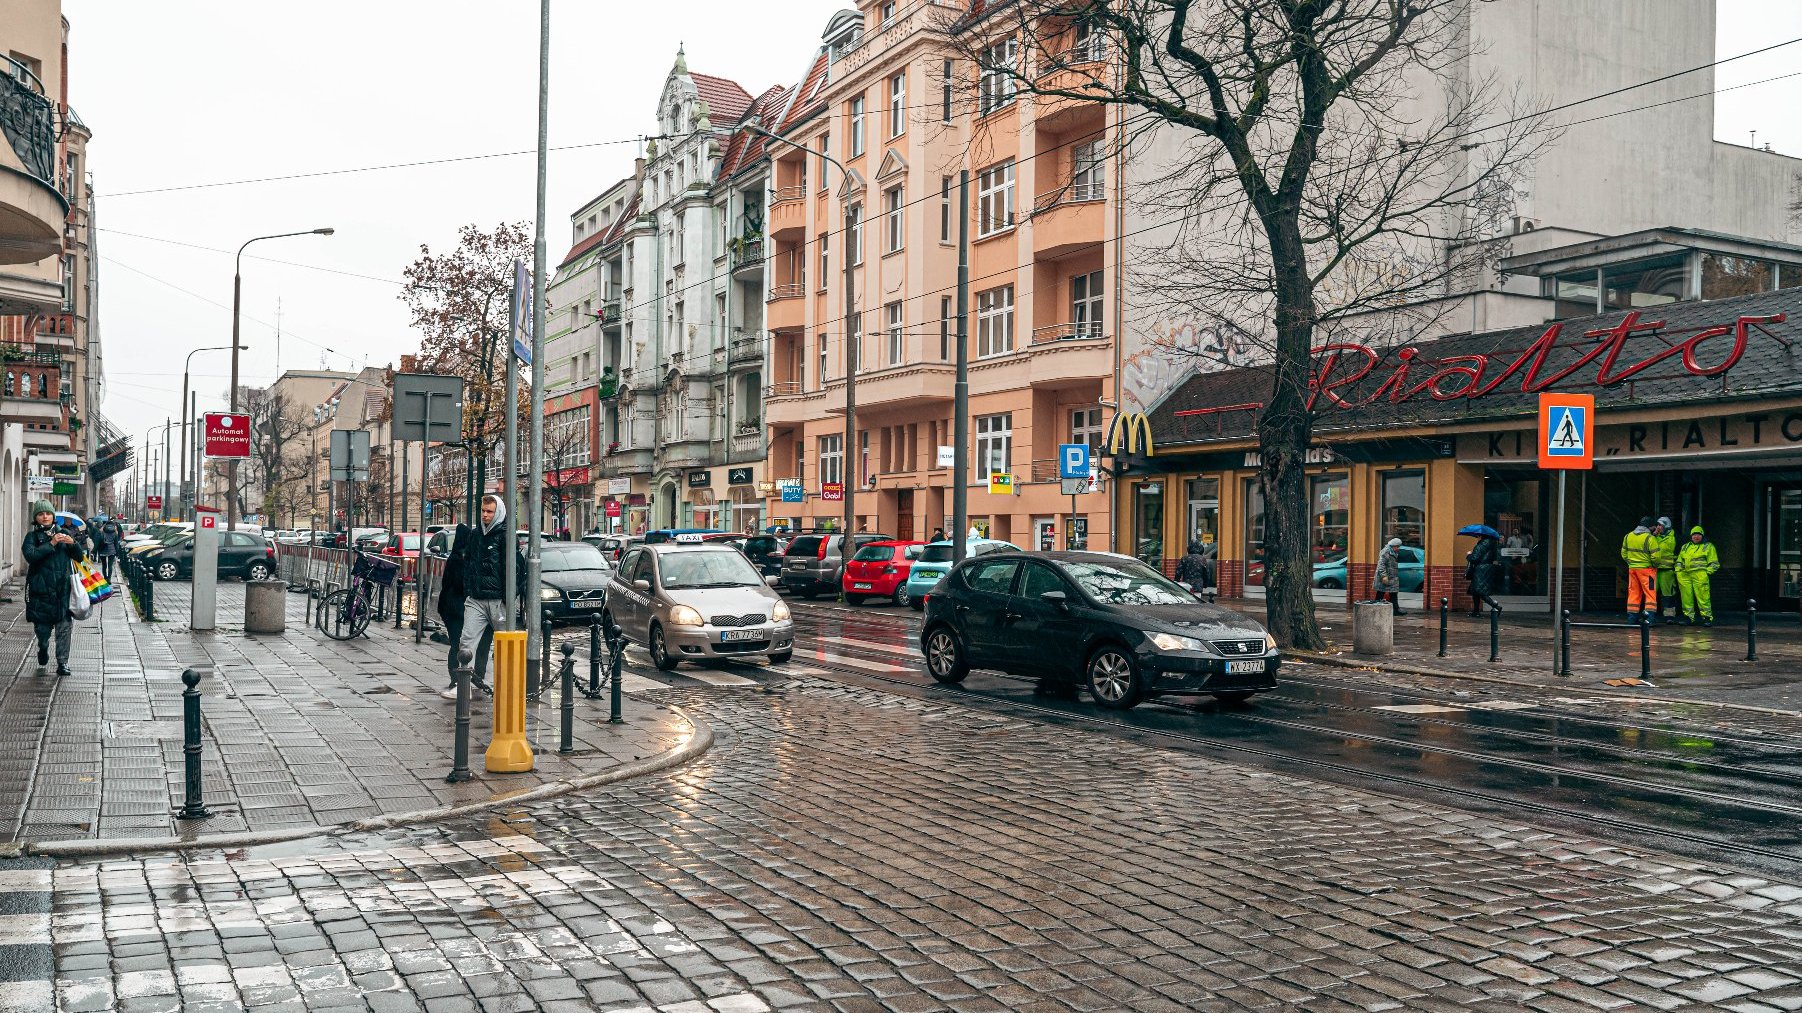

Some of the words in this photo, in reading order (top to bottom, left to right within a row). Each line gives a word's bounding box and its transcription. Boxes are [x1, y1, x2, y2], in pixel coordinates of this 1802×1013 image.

[1306, 310, 1787, 412] Rialto
[212, 427, 244, 435] Automat
[206, 435, 249, 444] parkingowy
[1066, 447, 1084, 474] P
[204, 518, 212, 527] P
[725, 631, 740, 640] KRA
[1230, 661, 1240, 672] WX
[1242, 660, 1264, 672] 2377A
